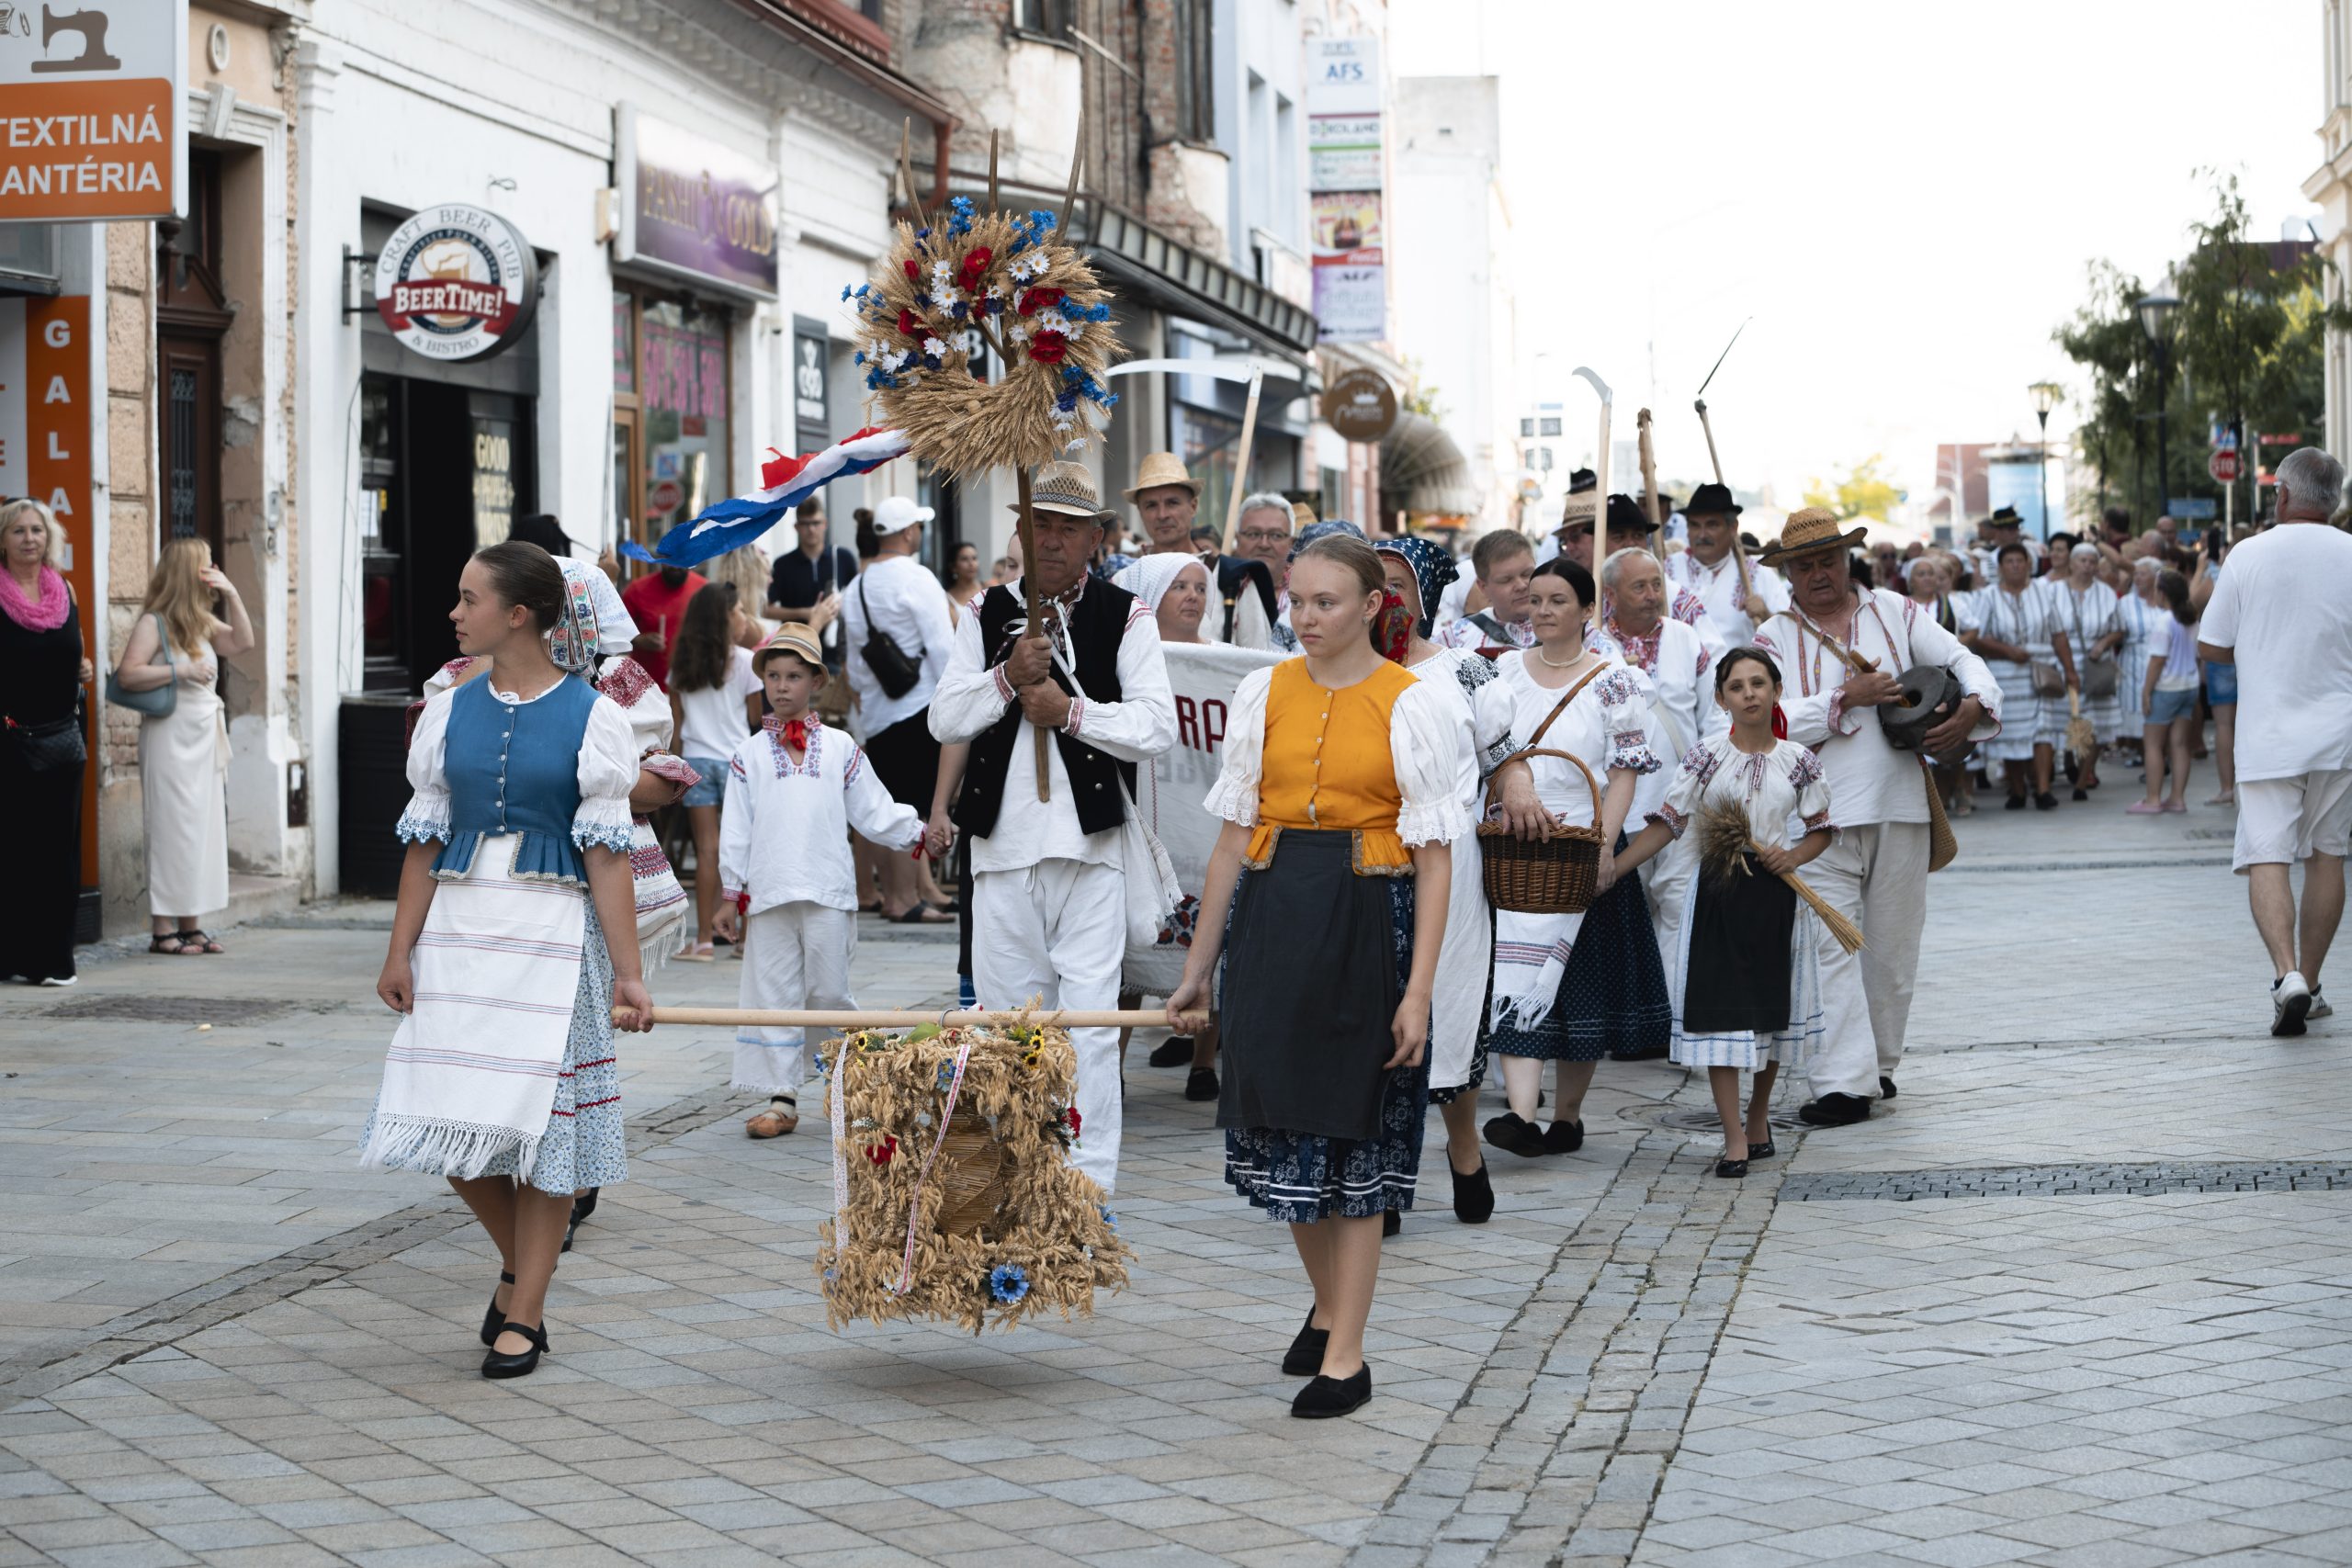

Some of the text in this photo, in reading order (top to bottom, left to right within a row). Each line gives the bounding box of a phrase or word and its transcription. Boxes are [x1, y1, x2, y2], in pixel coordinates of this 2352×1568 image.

[1327, 63, 1363, 80] AFS
[0, 154, 163, 196] ANTÉRIA
[381, 209, 520, 279] CRAFT BEER PUB
[726, 194, 773, 256] GOLD
[394, 283, 503, 318] BEERTIME!
[412, 334, 480, 355] & BISTRO
[475, 433, 510, 471] GOOD
